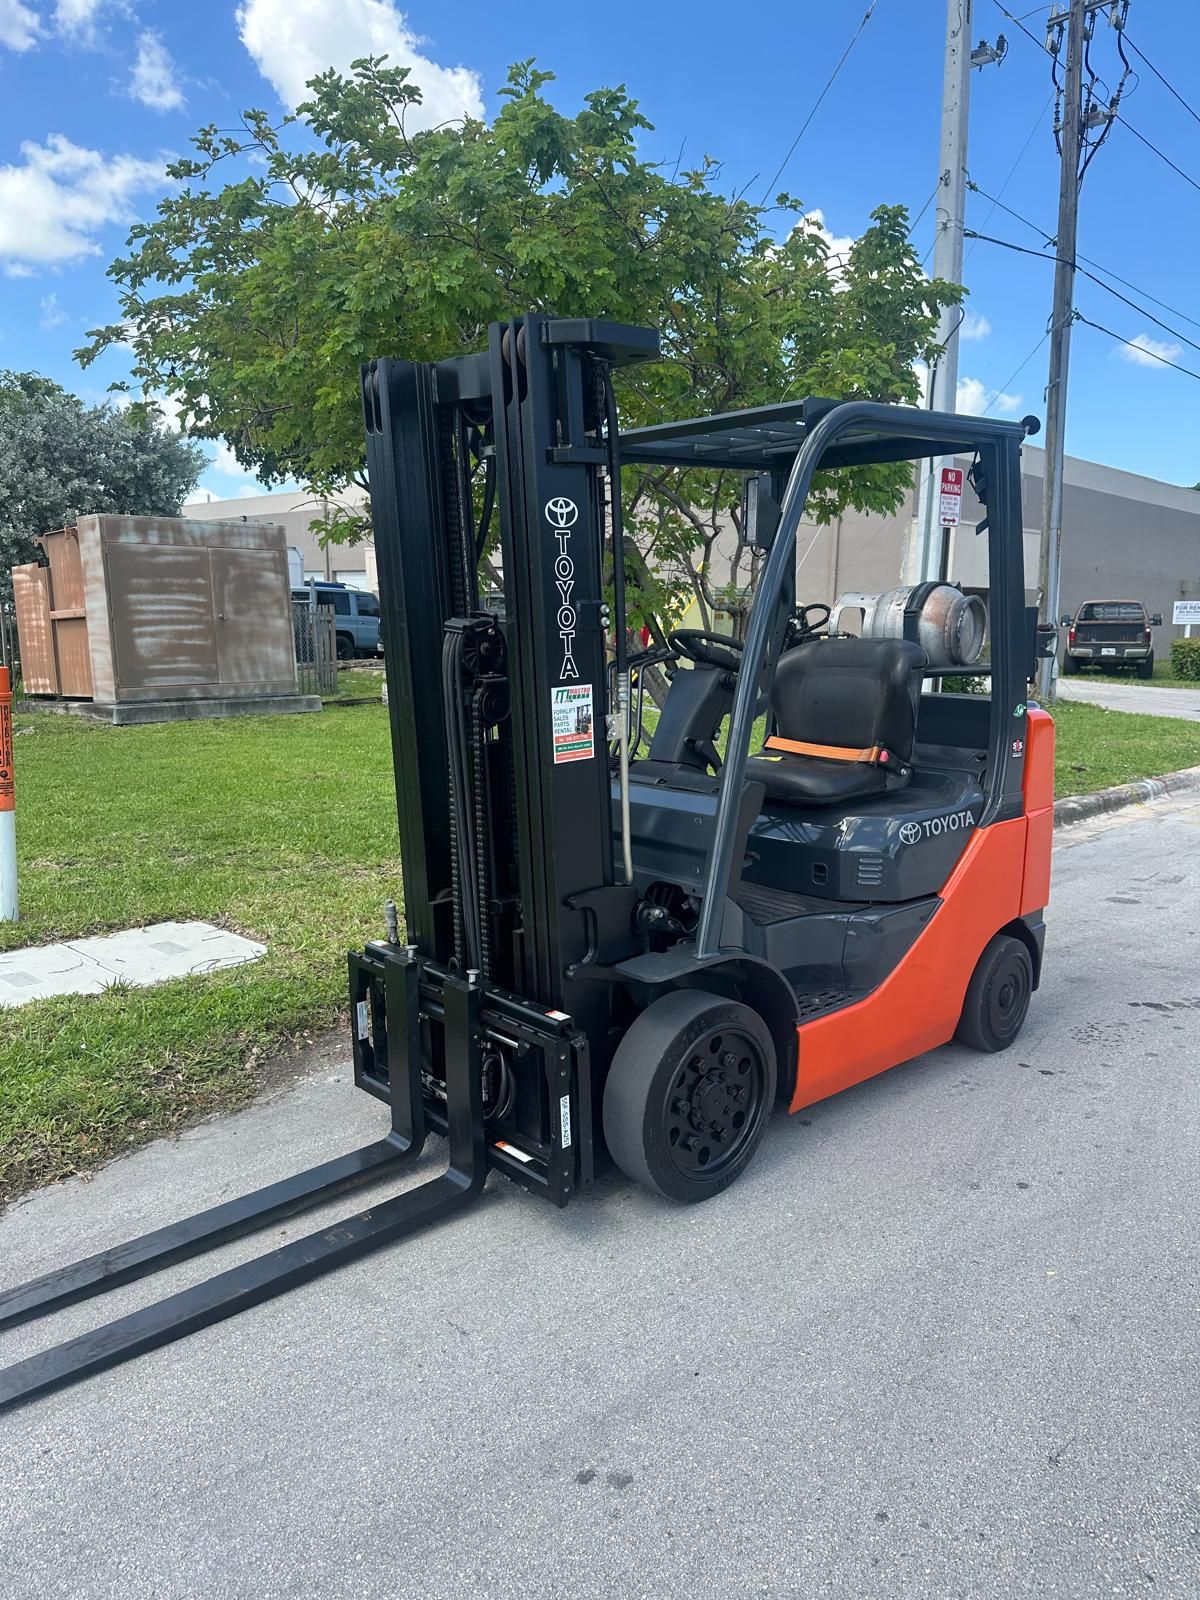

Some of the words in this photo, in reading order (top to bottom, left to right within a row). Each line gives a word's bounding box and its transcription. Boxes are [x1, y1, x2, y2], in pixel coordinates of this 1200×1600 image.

[947, 471, 956, 482] NO
[941, 482, 961, 494] PARKING
[555, 530, 580, 680] TOYOTA
[553, 708, 576, 716] FORKLIFT
[922, 810, 975, 837] TOYOTA
